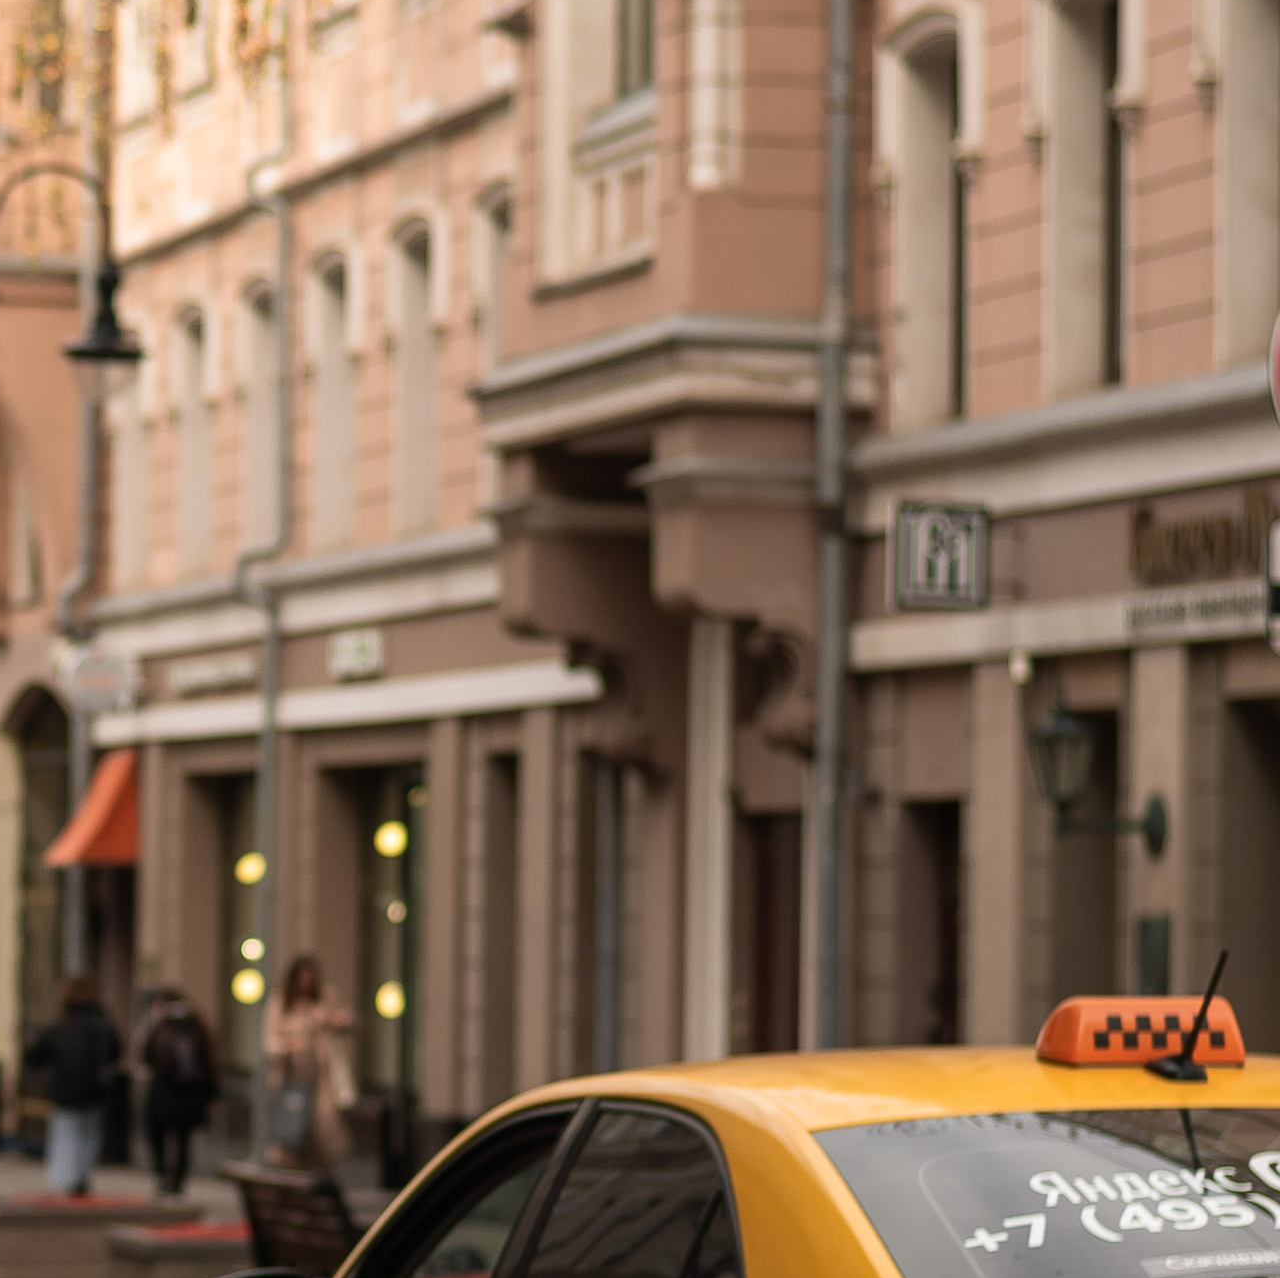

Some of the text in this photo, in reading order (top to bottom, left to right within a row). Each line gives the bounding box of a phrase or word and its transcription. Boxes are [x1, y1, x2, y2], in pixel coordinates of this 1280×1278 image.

[1029, 1166, 1252, 1208] Яндекс
[964, 1193, 1280, 1253] +7 (495)
